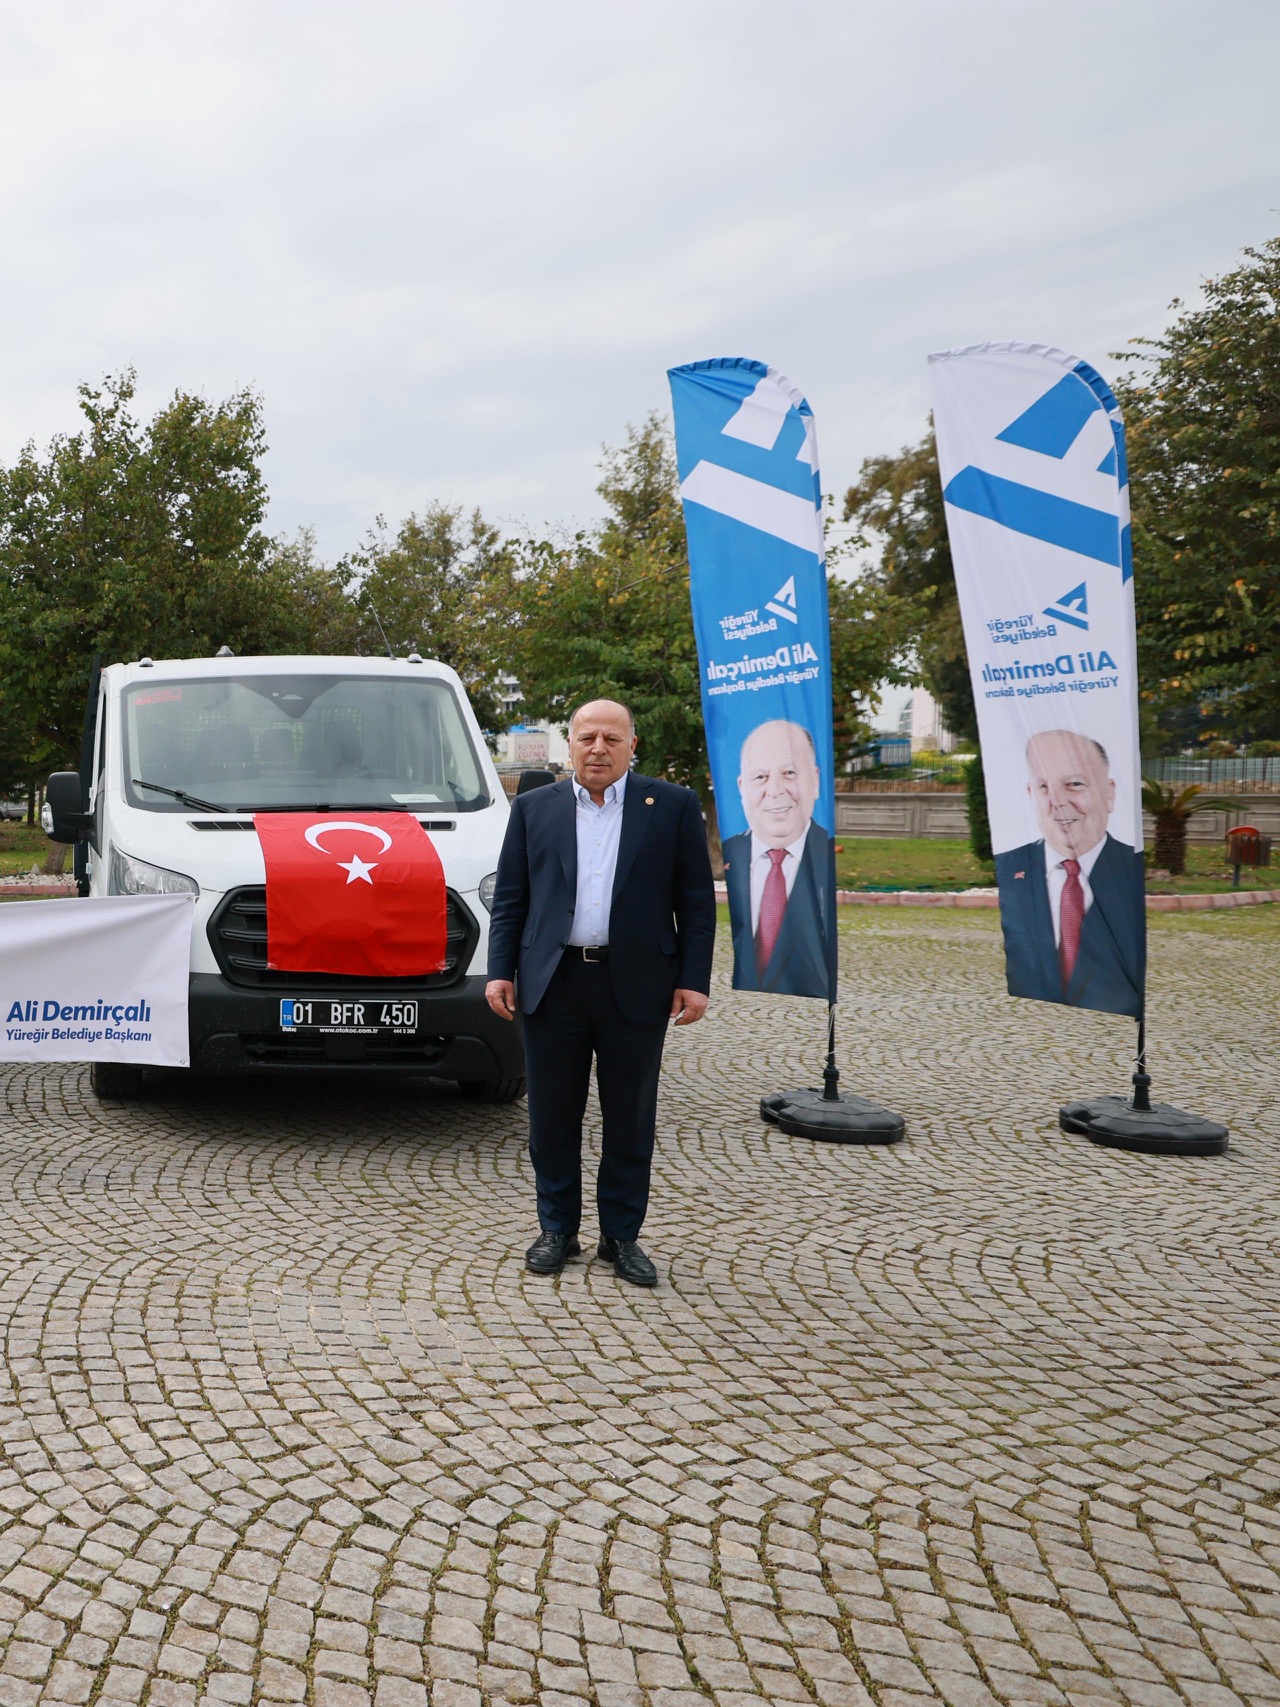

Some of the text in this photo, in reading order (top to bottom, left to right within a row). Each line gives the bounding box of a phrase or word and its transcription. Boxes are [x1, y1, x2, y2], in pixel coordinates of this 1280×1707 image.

[6, 999, 151, 1026] Ali Demirçalı
[293, 1003, 313, 1024] 01
[330, 1003, 365, 1025] BFR
[380, 1004, 415, 1026] 450
[6, 1028, 152, 1043] Yüreğir Belediye Başkanı
